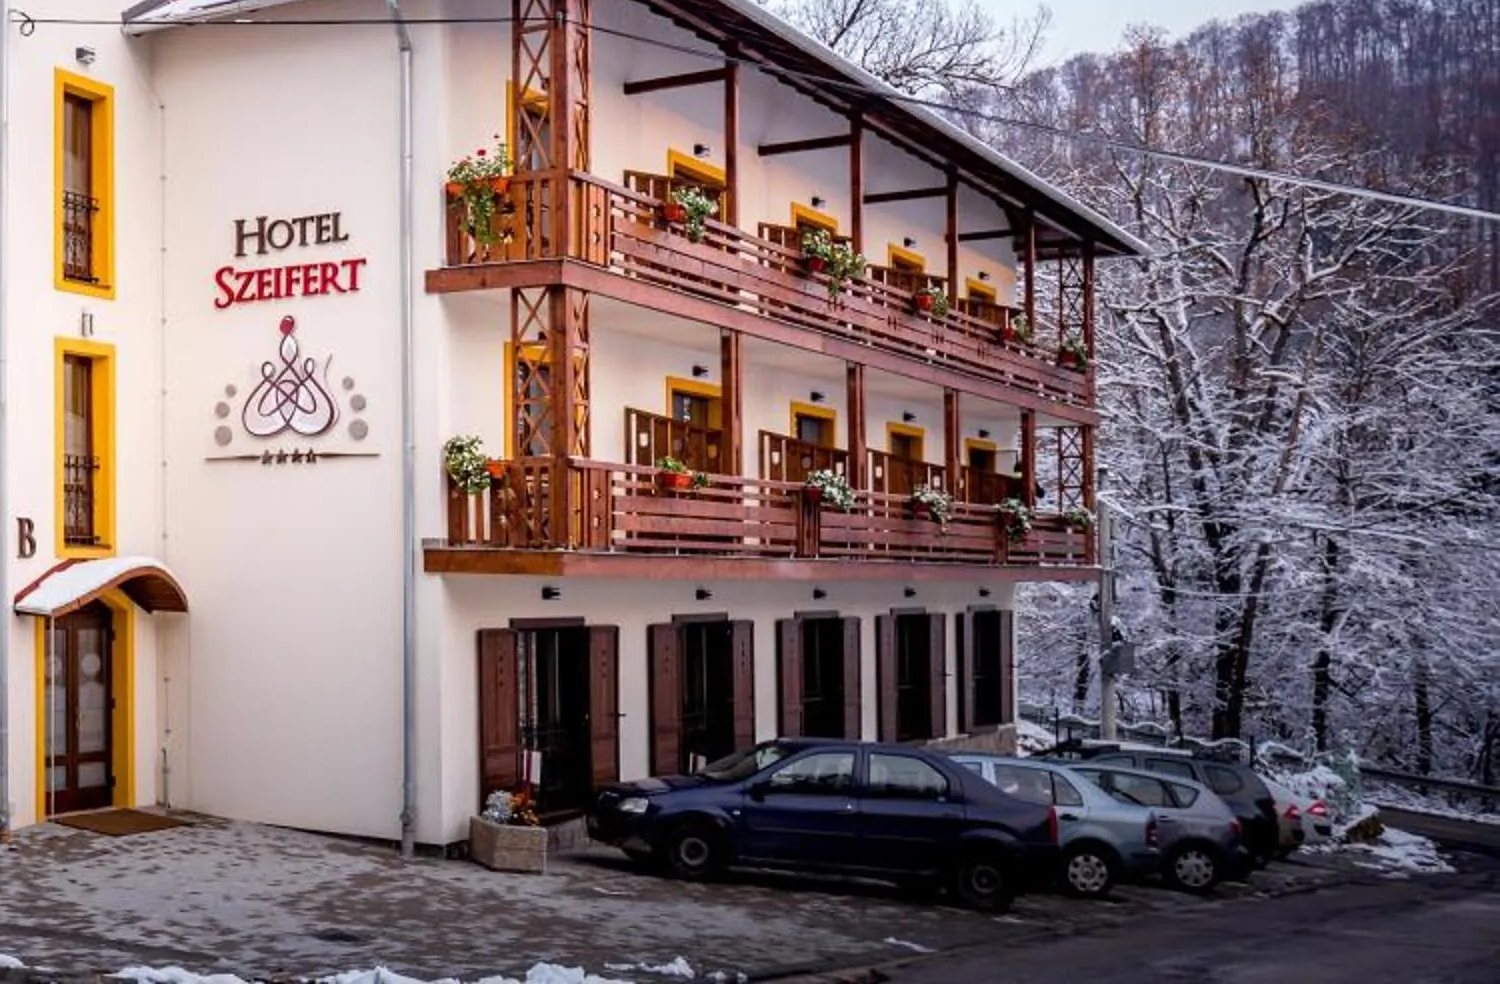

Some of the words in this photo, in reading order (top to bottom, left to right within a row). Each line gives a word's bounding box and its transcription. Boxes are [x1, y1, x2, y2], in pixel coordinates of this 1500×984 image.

[234, 212, 349, 257] HOTEL
[214, 258, 367, 309] SZEIFERT
[16, 517, 37, 559] B
